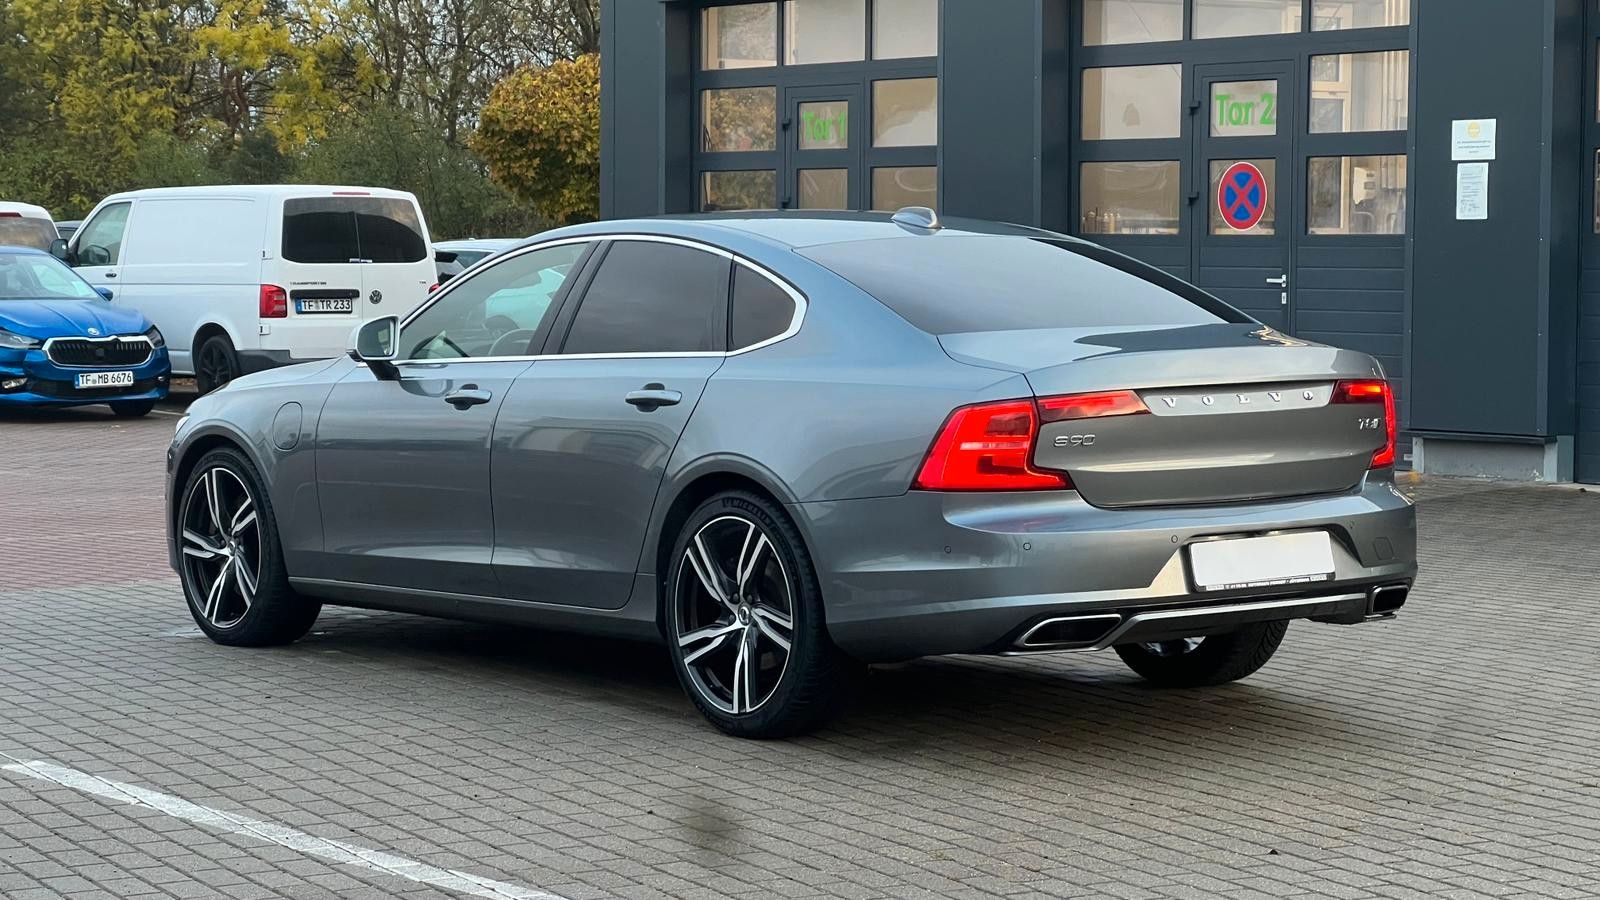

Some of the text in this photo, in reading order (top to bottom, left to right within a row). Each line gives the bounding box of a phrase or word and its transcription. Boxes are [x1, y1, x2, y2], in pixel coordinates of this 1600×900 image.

[1215, 93, 1275, 126] Tor 2
[803, 111, 846, 144] Tor 1
[302, 299, 351, 310] TF TR 233
[80, 372, 132, 385] TF MB 6676
[1161, 390, 1314, 408] VOLVO
[1054, 434, 1096, 447] S90
